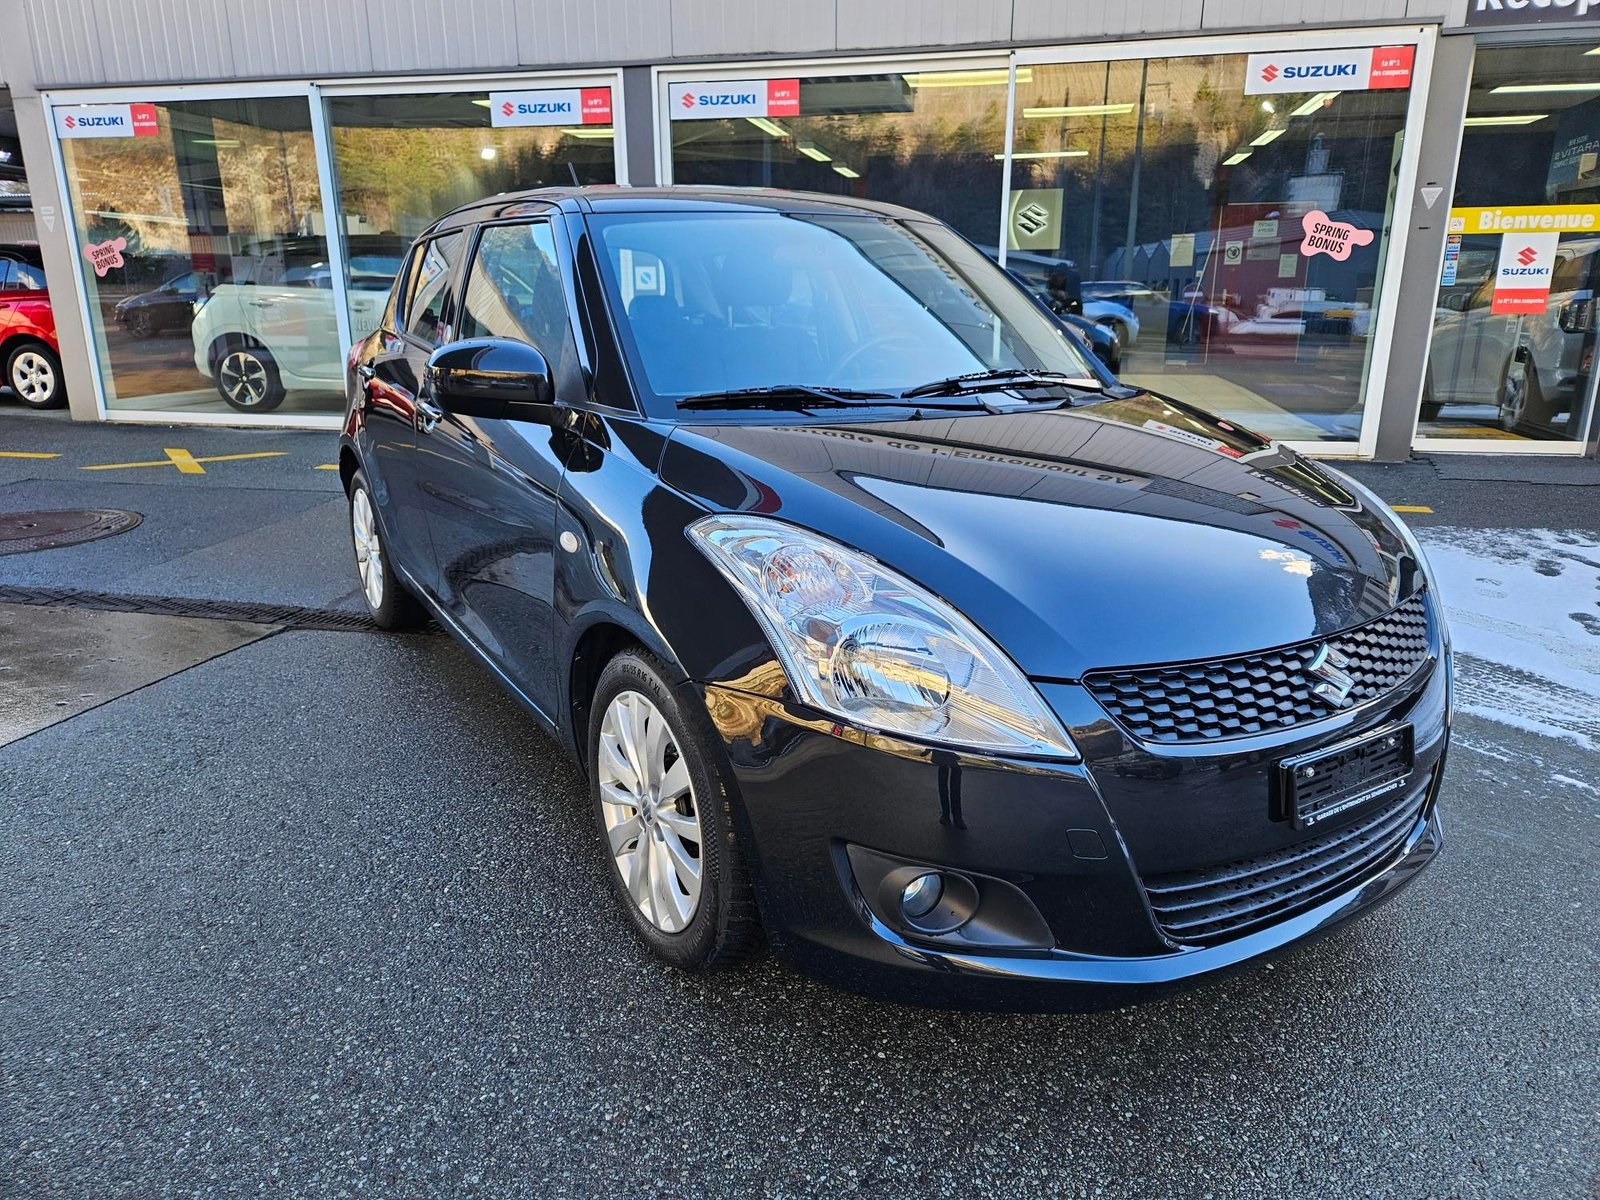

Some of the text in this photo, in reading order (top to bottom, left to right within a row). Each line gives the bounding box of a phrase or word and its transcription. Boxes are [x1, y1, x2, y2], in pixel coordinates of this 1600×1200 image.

[1283, 63, 1358, 79] SUZUKI
[518, 102, 571, 114] SUZUKI
[699, 94, 756, 106] SUZUKI
[78, 116, 124, 127] SUZUKI
[1561, 140, 1600, 158] VITARA
[1478, 209, 1596, 230] Bienvenue
[1312, 222, 1350, 241] SPRING
[91, 244, 115, 260] SPRING
[1307, 235, 1345, 254] BONUS
[95, 254, 119, 270] BONUS
[1502, 267, 1549, 276] SUZUKI
